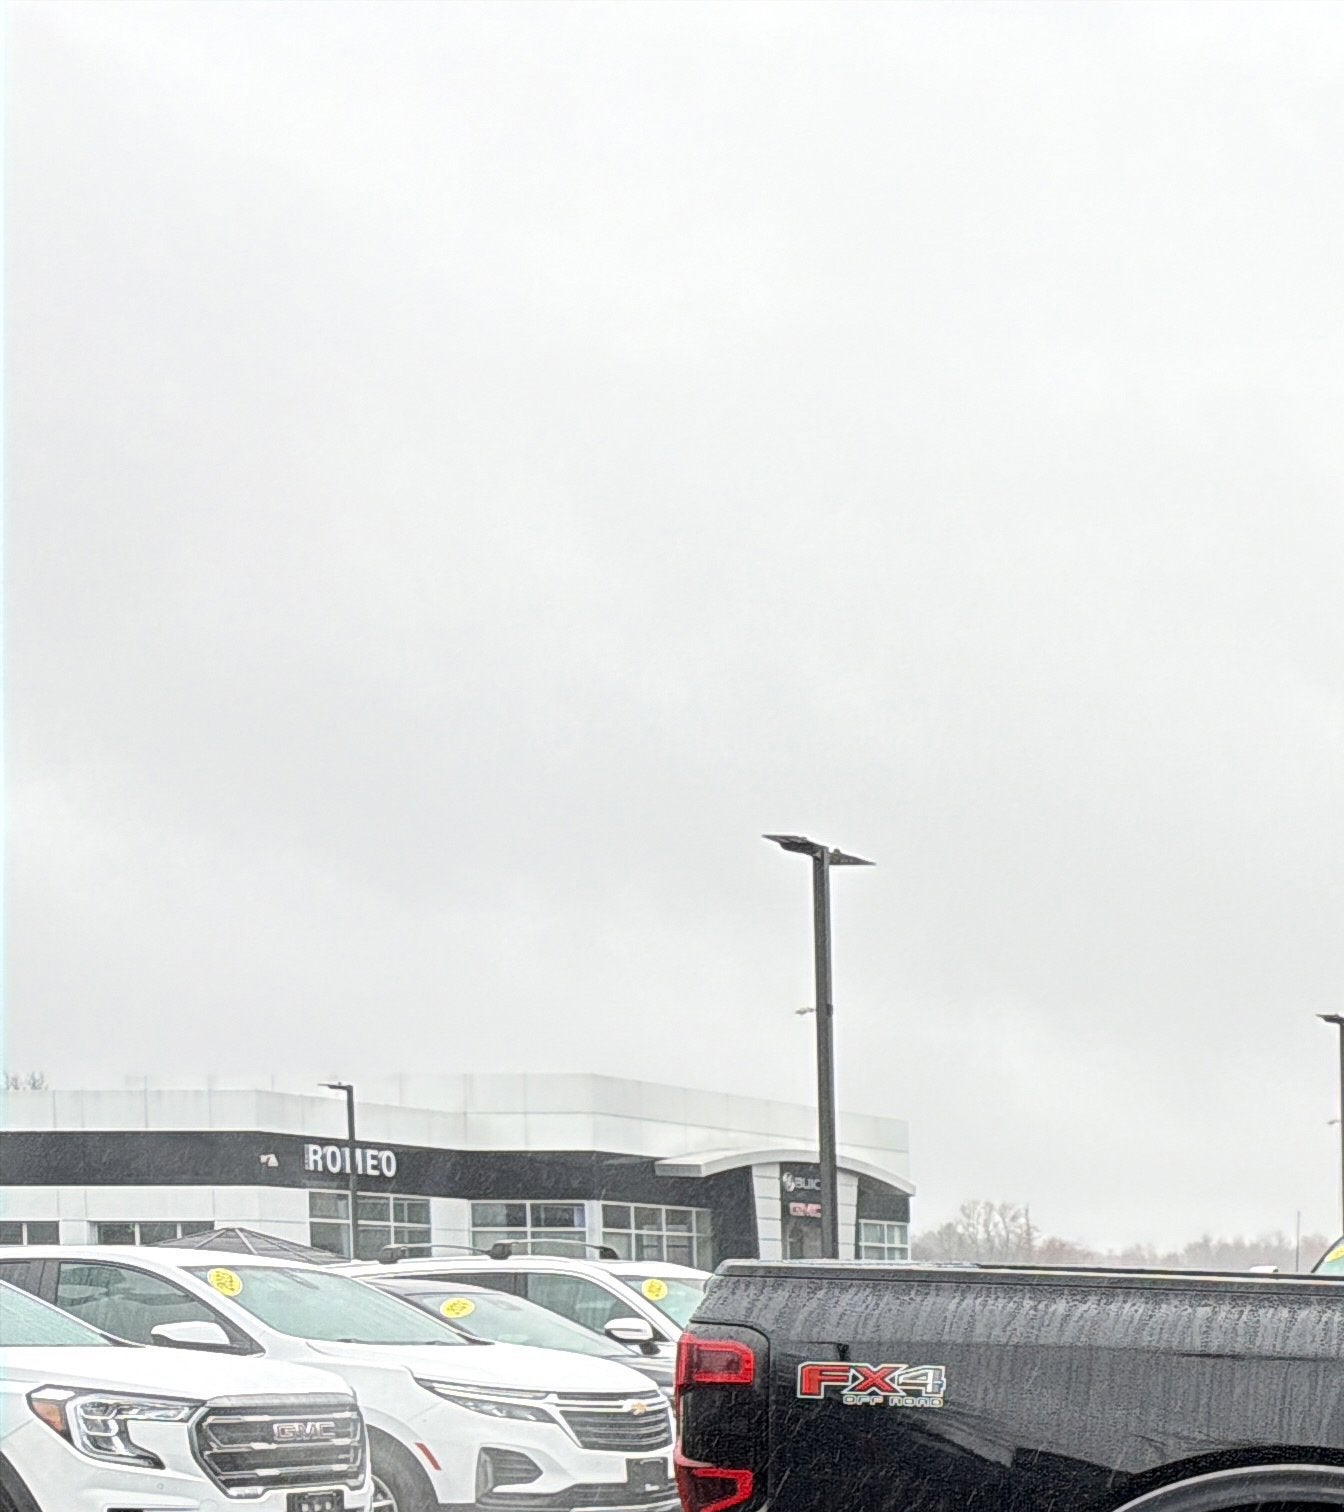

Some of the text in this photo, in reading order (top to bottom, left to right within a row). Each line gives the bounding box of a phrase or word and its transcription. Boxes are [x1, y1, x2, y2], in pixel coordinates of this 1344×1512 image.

[304, 1144, 397, 1178] ROMEO
[794, 1177, 821, 1190] BUIC
[797, 1361, 947, 1399] FX4
[842, 1394, 944, 1407] OFF ROAD
[273, 1422, 336, 1441] GMC
